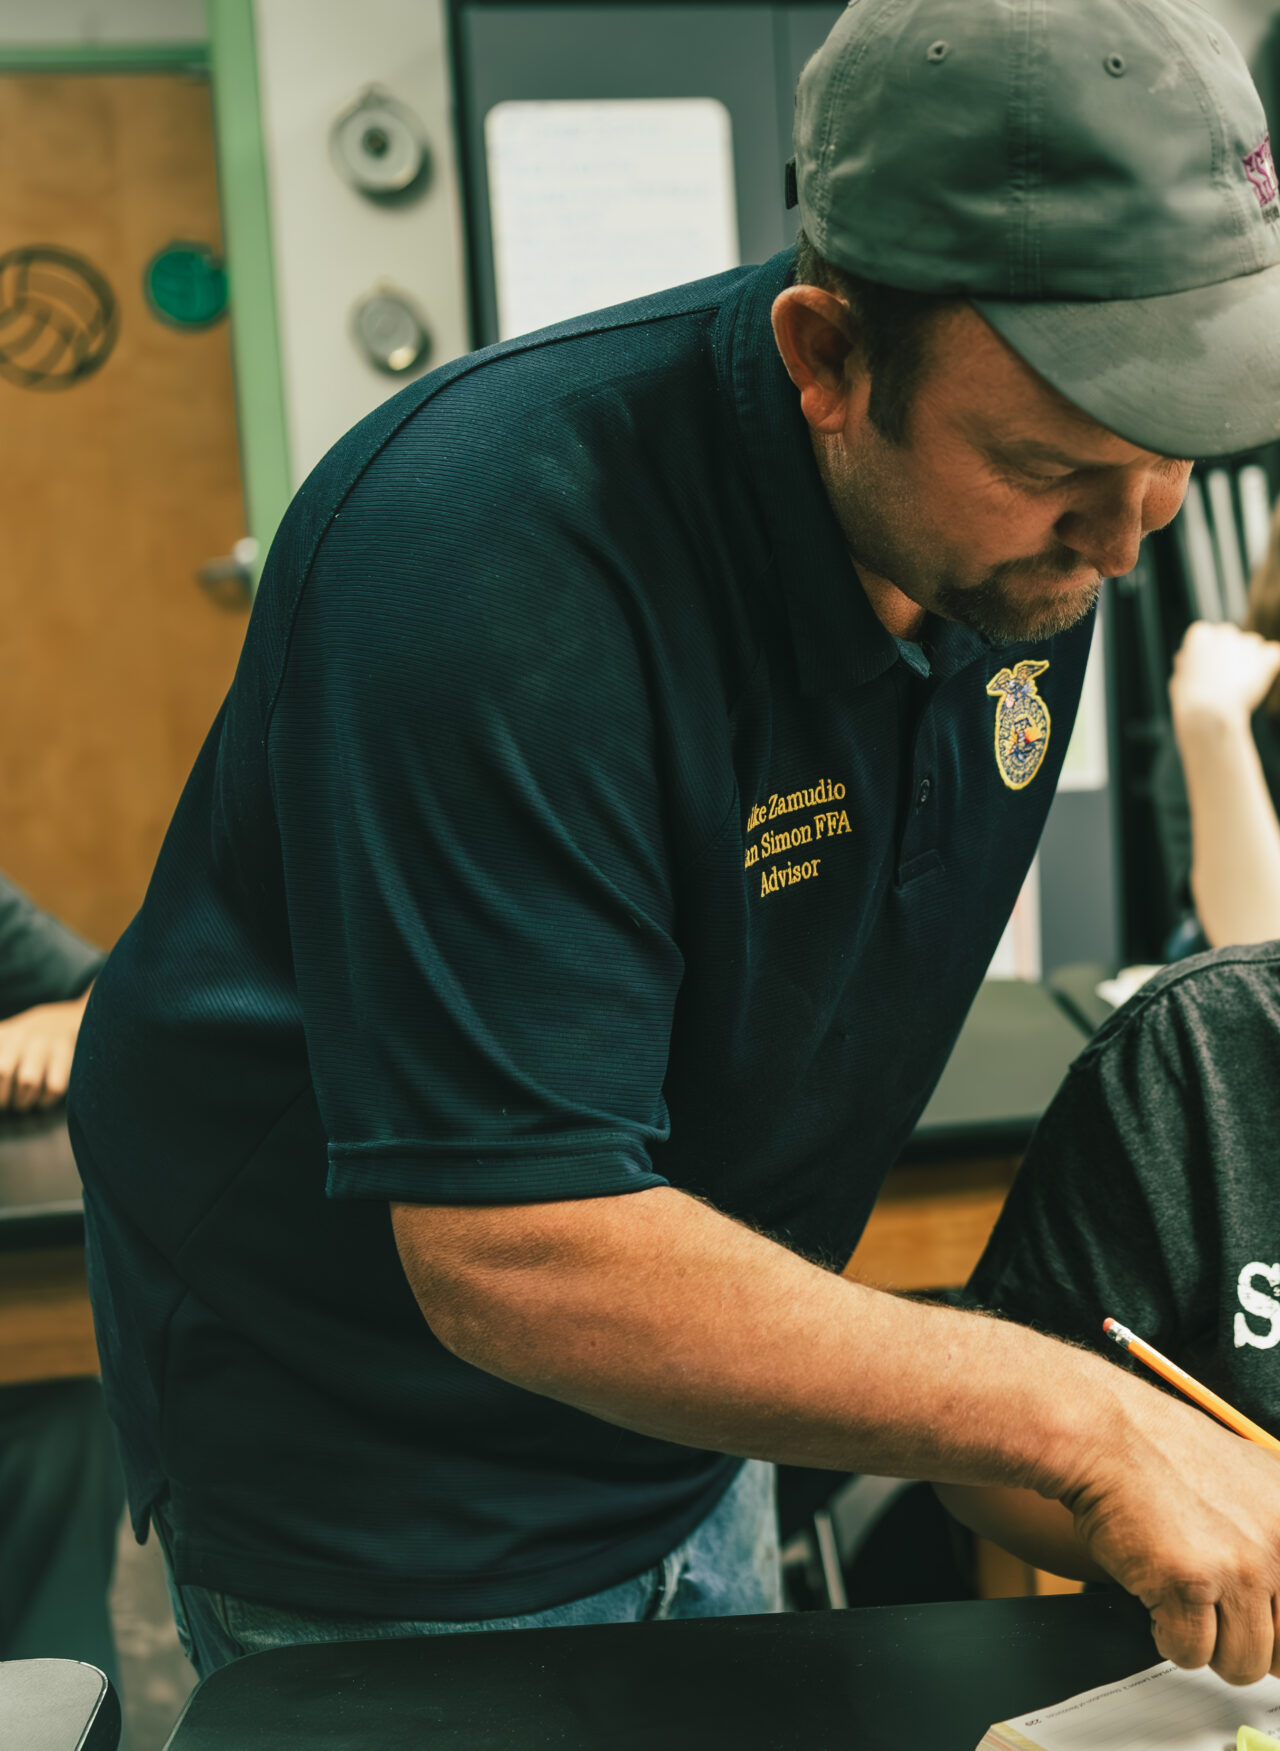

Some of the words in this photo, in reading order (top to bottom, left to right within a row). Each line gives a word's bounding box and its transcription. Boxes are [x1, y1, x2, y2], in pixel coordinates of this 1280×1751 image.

[768, 778, 846, 821] Zamudio
[745, 844, 760, 870] an
[761, 829, 813, 859] Simon
[813, 809, 853, 840] FFA
[761, 858, 821, 898] Advisor
